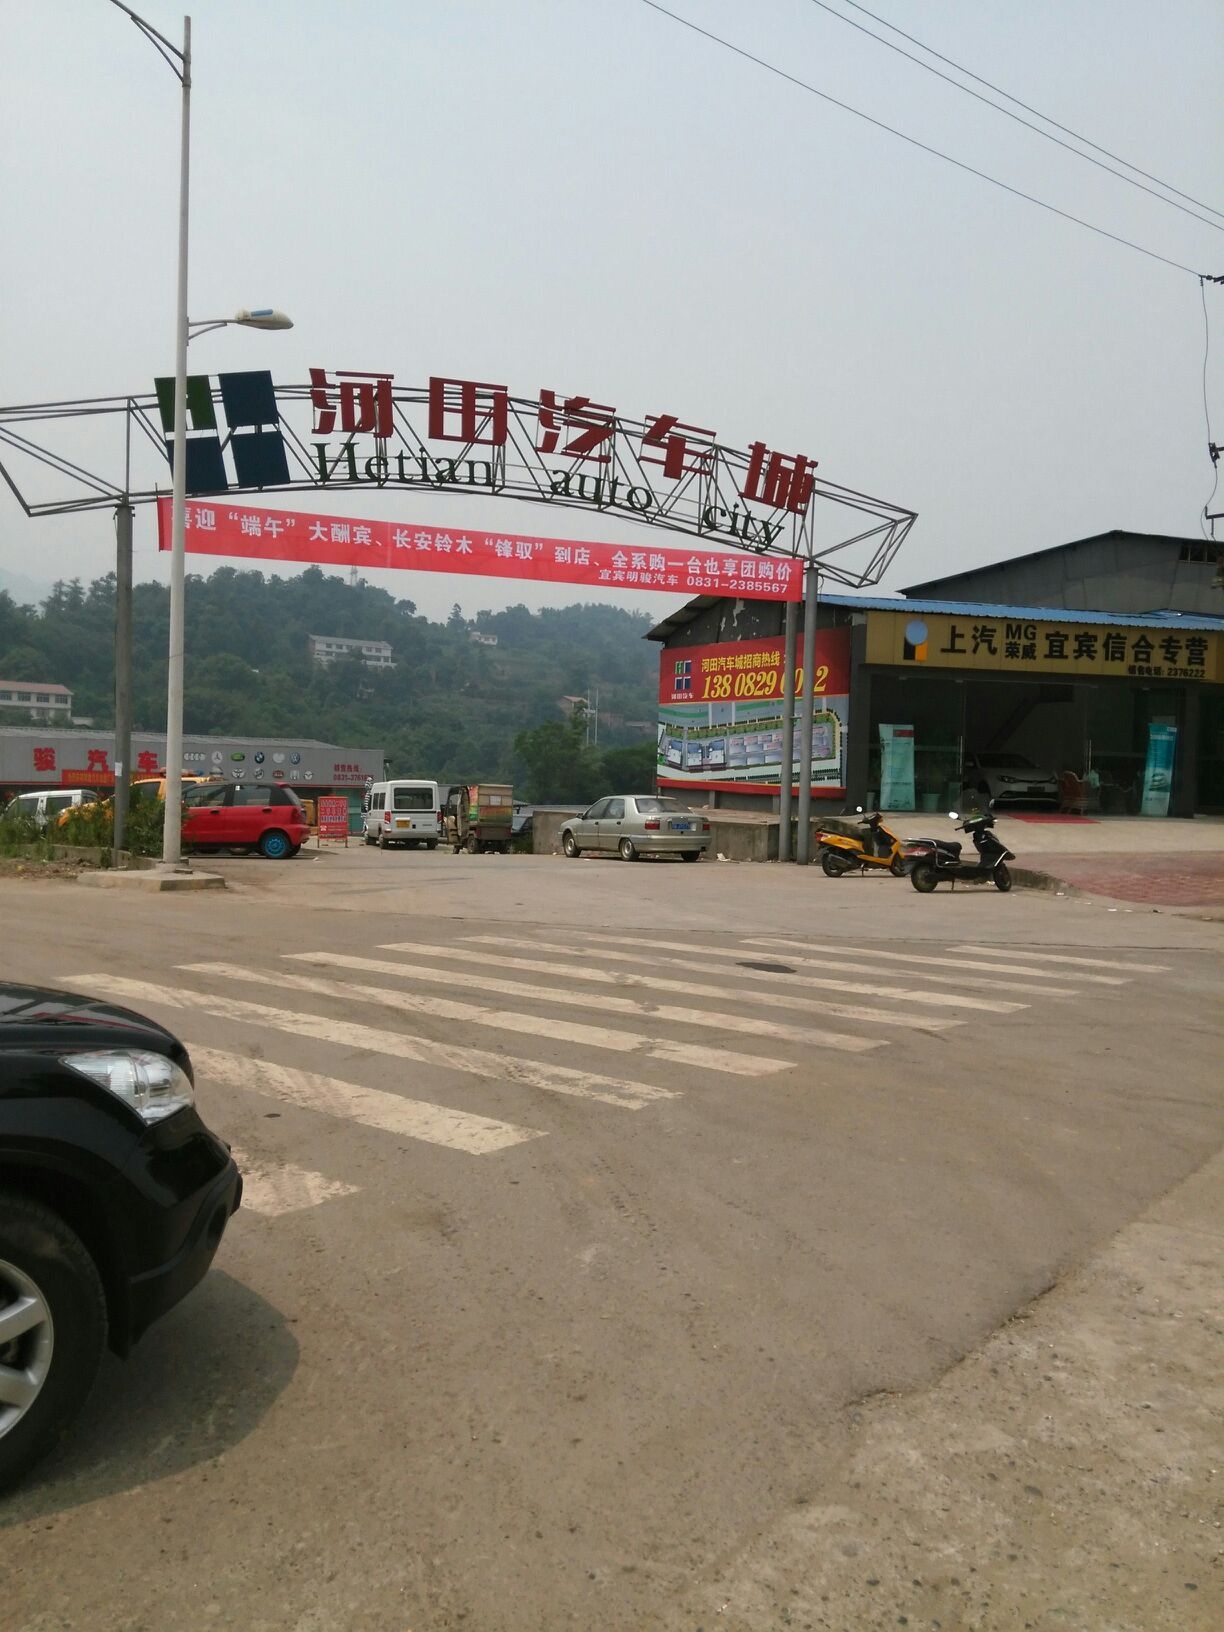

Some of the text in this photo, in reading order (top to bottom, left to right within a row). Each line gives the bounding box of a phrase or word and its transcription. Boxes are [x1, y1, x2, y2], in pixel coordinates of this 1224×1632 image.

[310, 442, 785, 553] Hetian auto city
[686, 577, 788, 593] 0831-2385567
[941, 624, 1208, 666] 上汽 MG 宜宾信合专营
